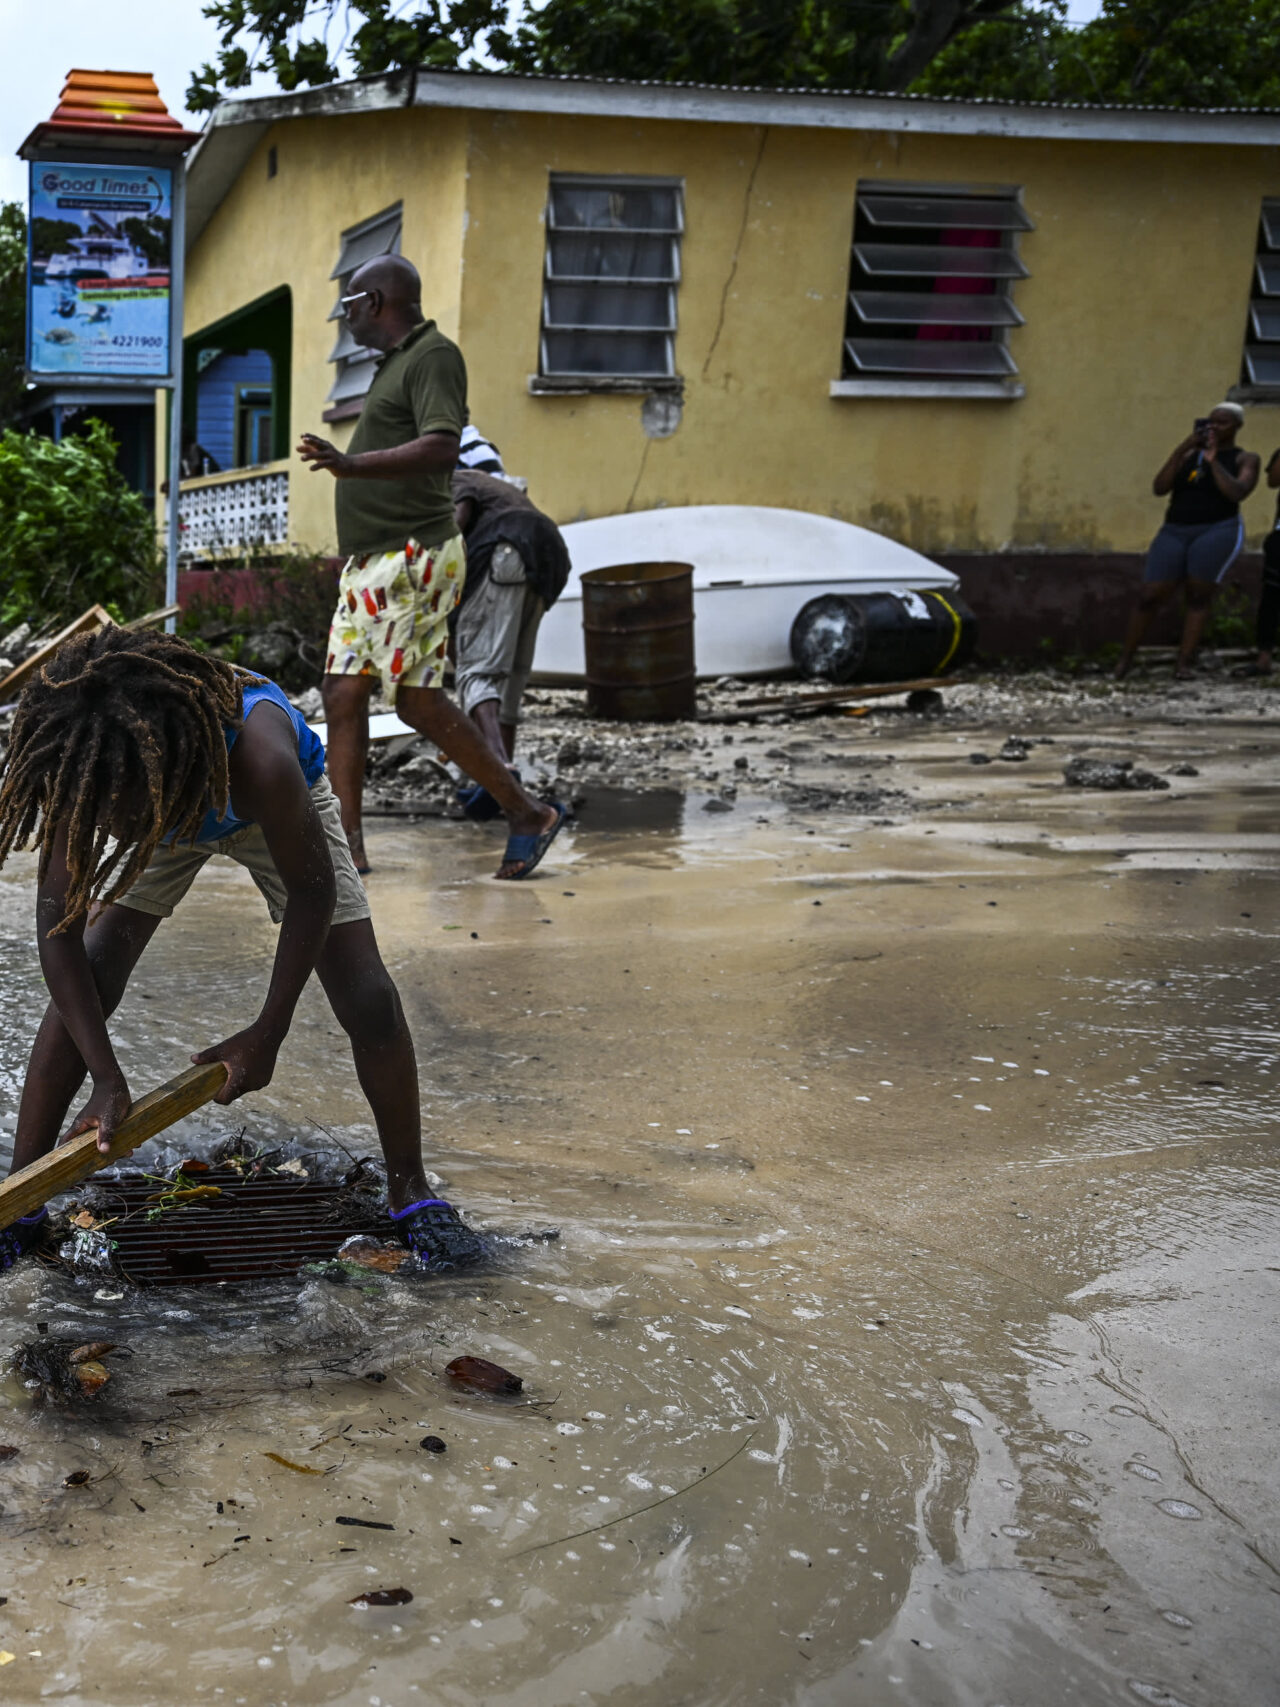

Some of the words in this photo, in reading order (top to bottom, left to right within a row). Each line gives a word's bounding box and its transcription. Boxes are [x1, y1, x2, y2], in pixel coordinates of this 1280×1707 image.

[42, 173, 96, 192] Good
[101, 178, 149, 195] Times
[112, 335, 163, 348] 4221900
